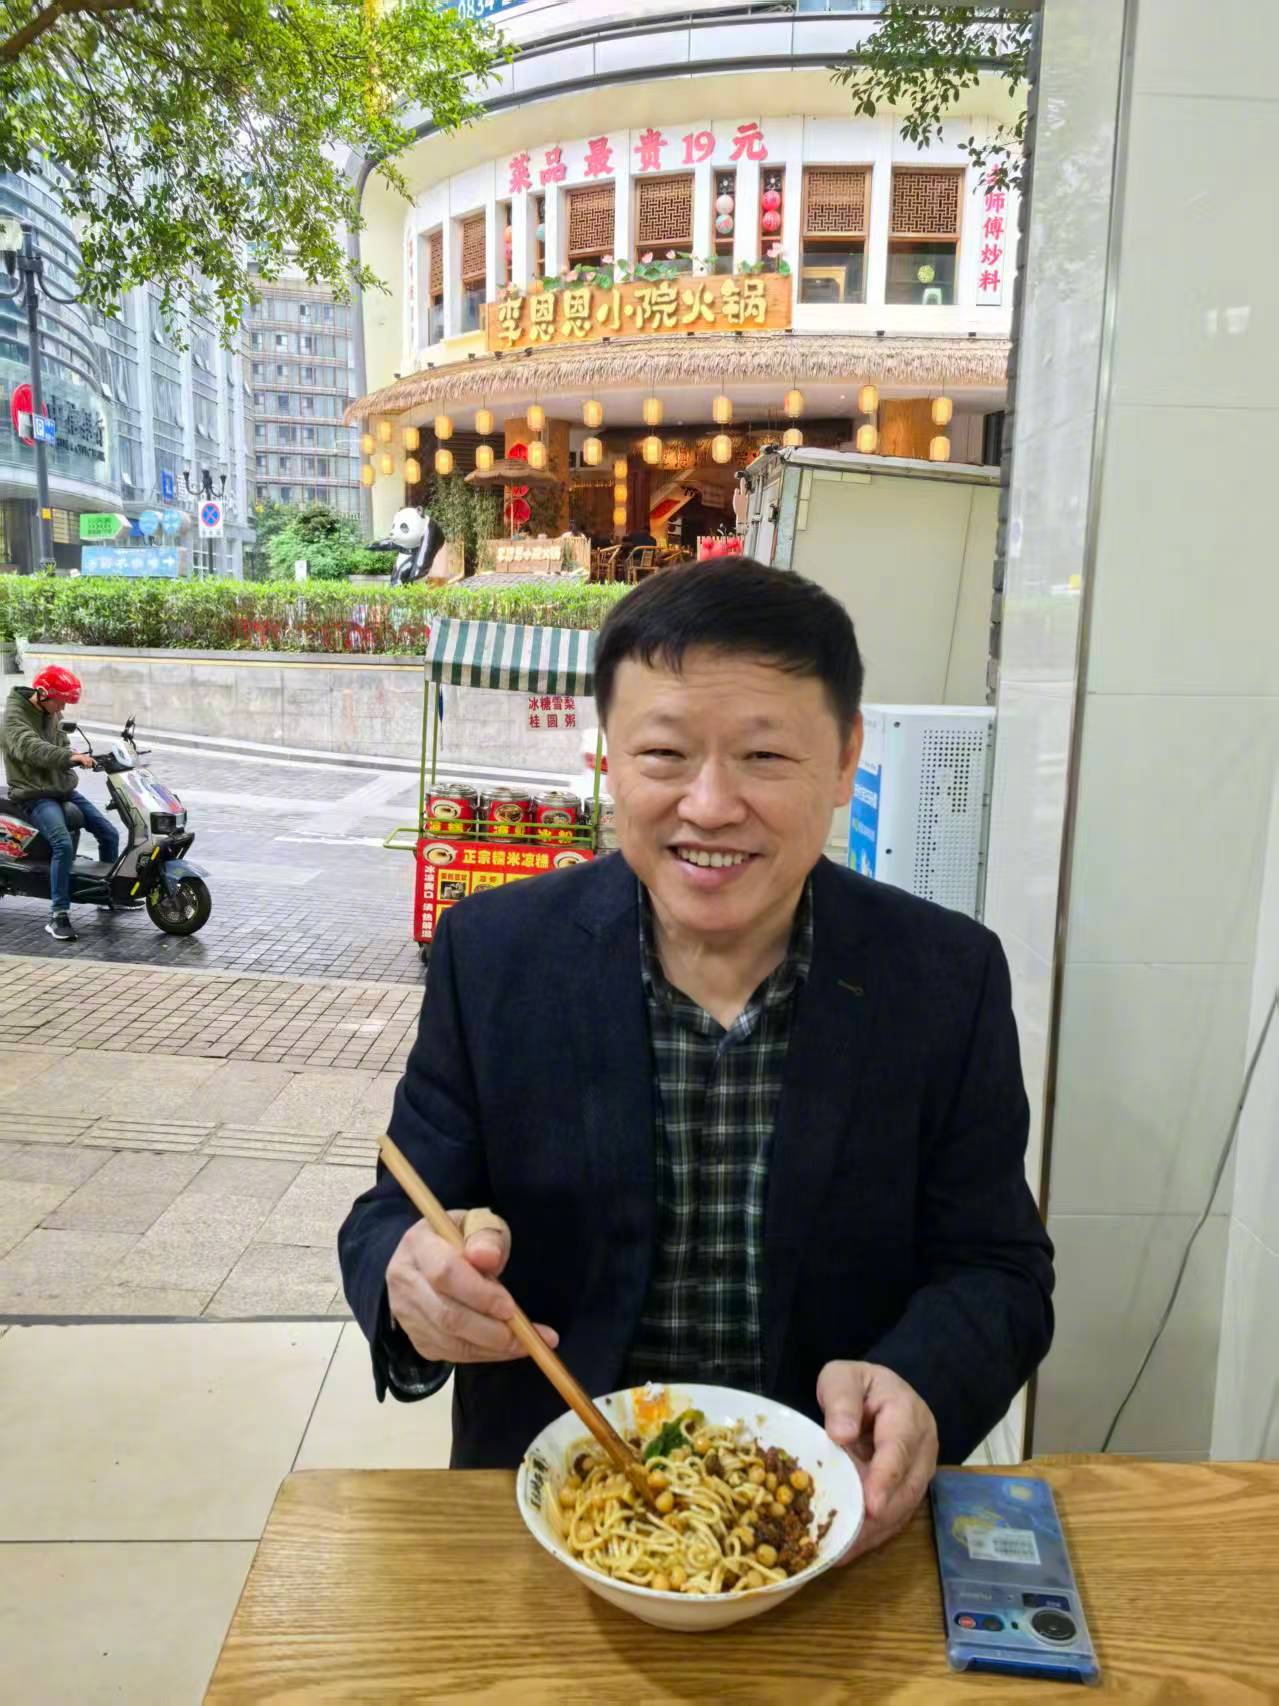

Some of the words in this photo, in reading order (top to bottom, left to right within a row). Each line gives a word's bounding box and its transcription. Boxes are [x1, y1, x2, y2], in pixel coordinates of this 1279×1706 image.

[509, 122, 768, 193] 菜品最贵19元
[497, 279, 767, 347] 李恩恩小院火锅
[528, 695, 576, 711] 冰糖雪梨
